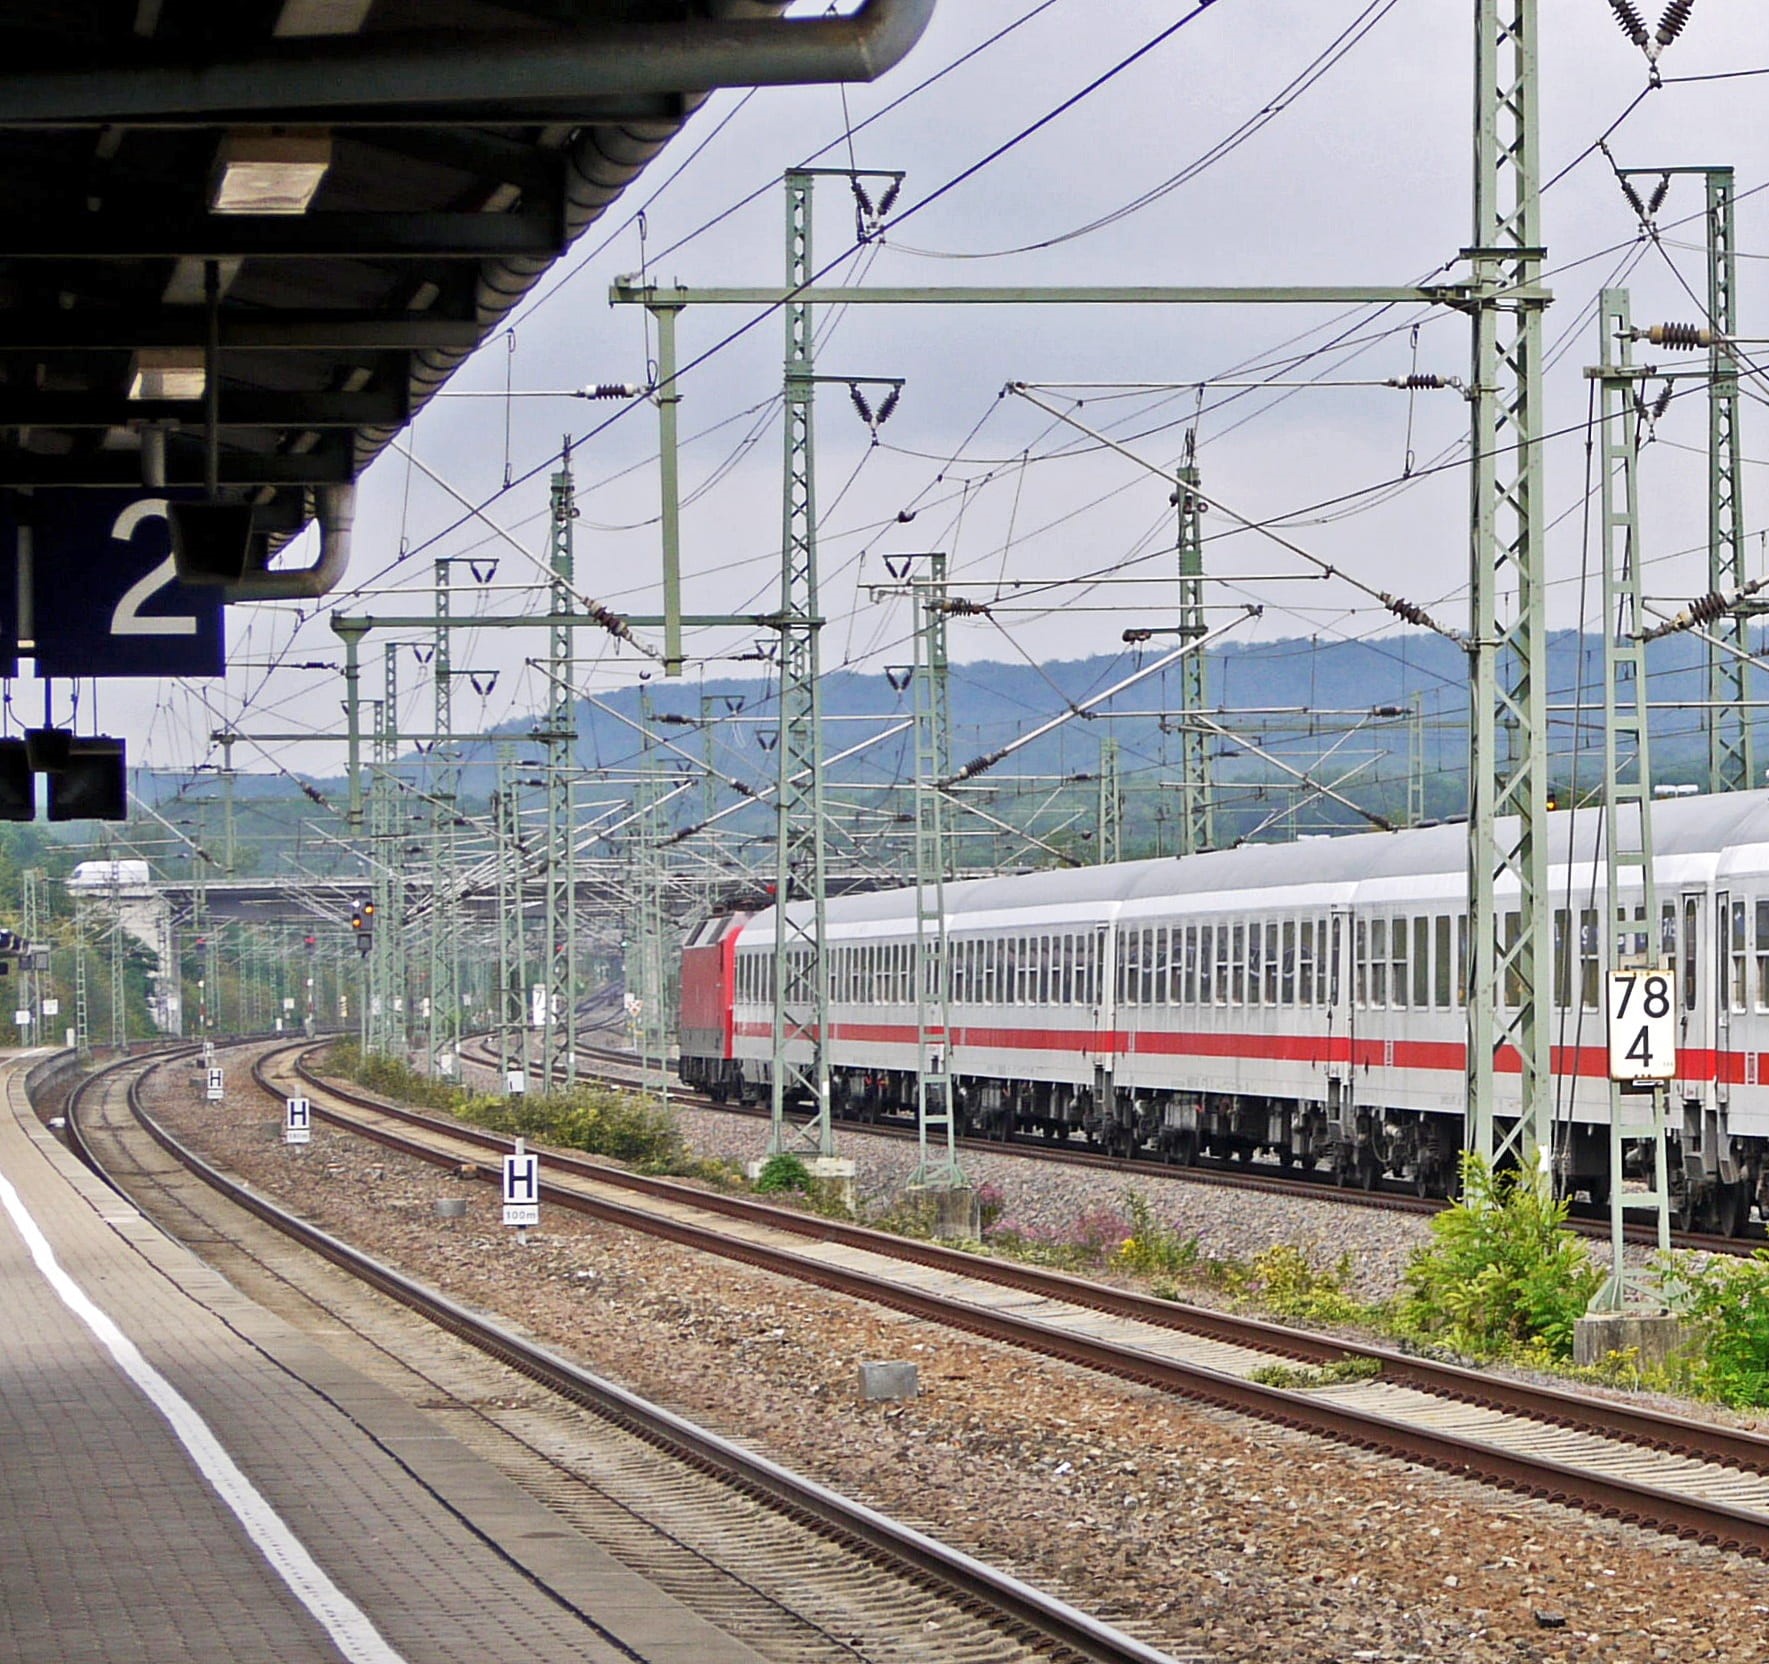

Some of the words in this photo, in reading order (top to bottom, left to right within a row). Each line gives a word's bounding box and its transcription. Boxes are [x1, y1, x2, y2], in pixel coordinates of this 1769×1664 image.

[110, 498, 197, 635] 2
[1614, 976, 1669, 1019] 78
[1624, 1025, 1653, 1068] 4
[210, 1070, 221, 1087] H
[290, 1101, 306, 1126] H
[508, 1160, 533, 1198] H
